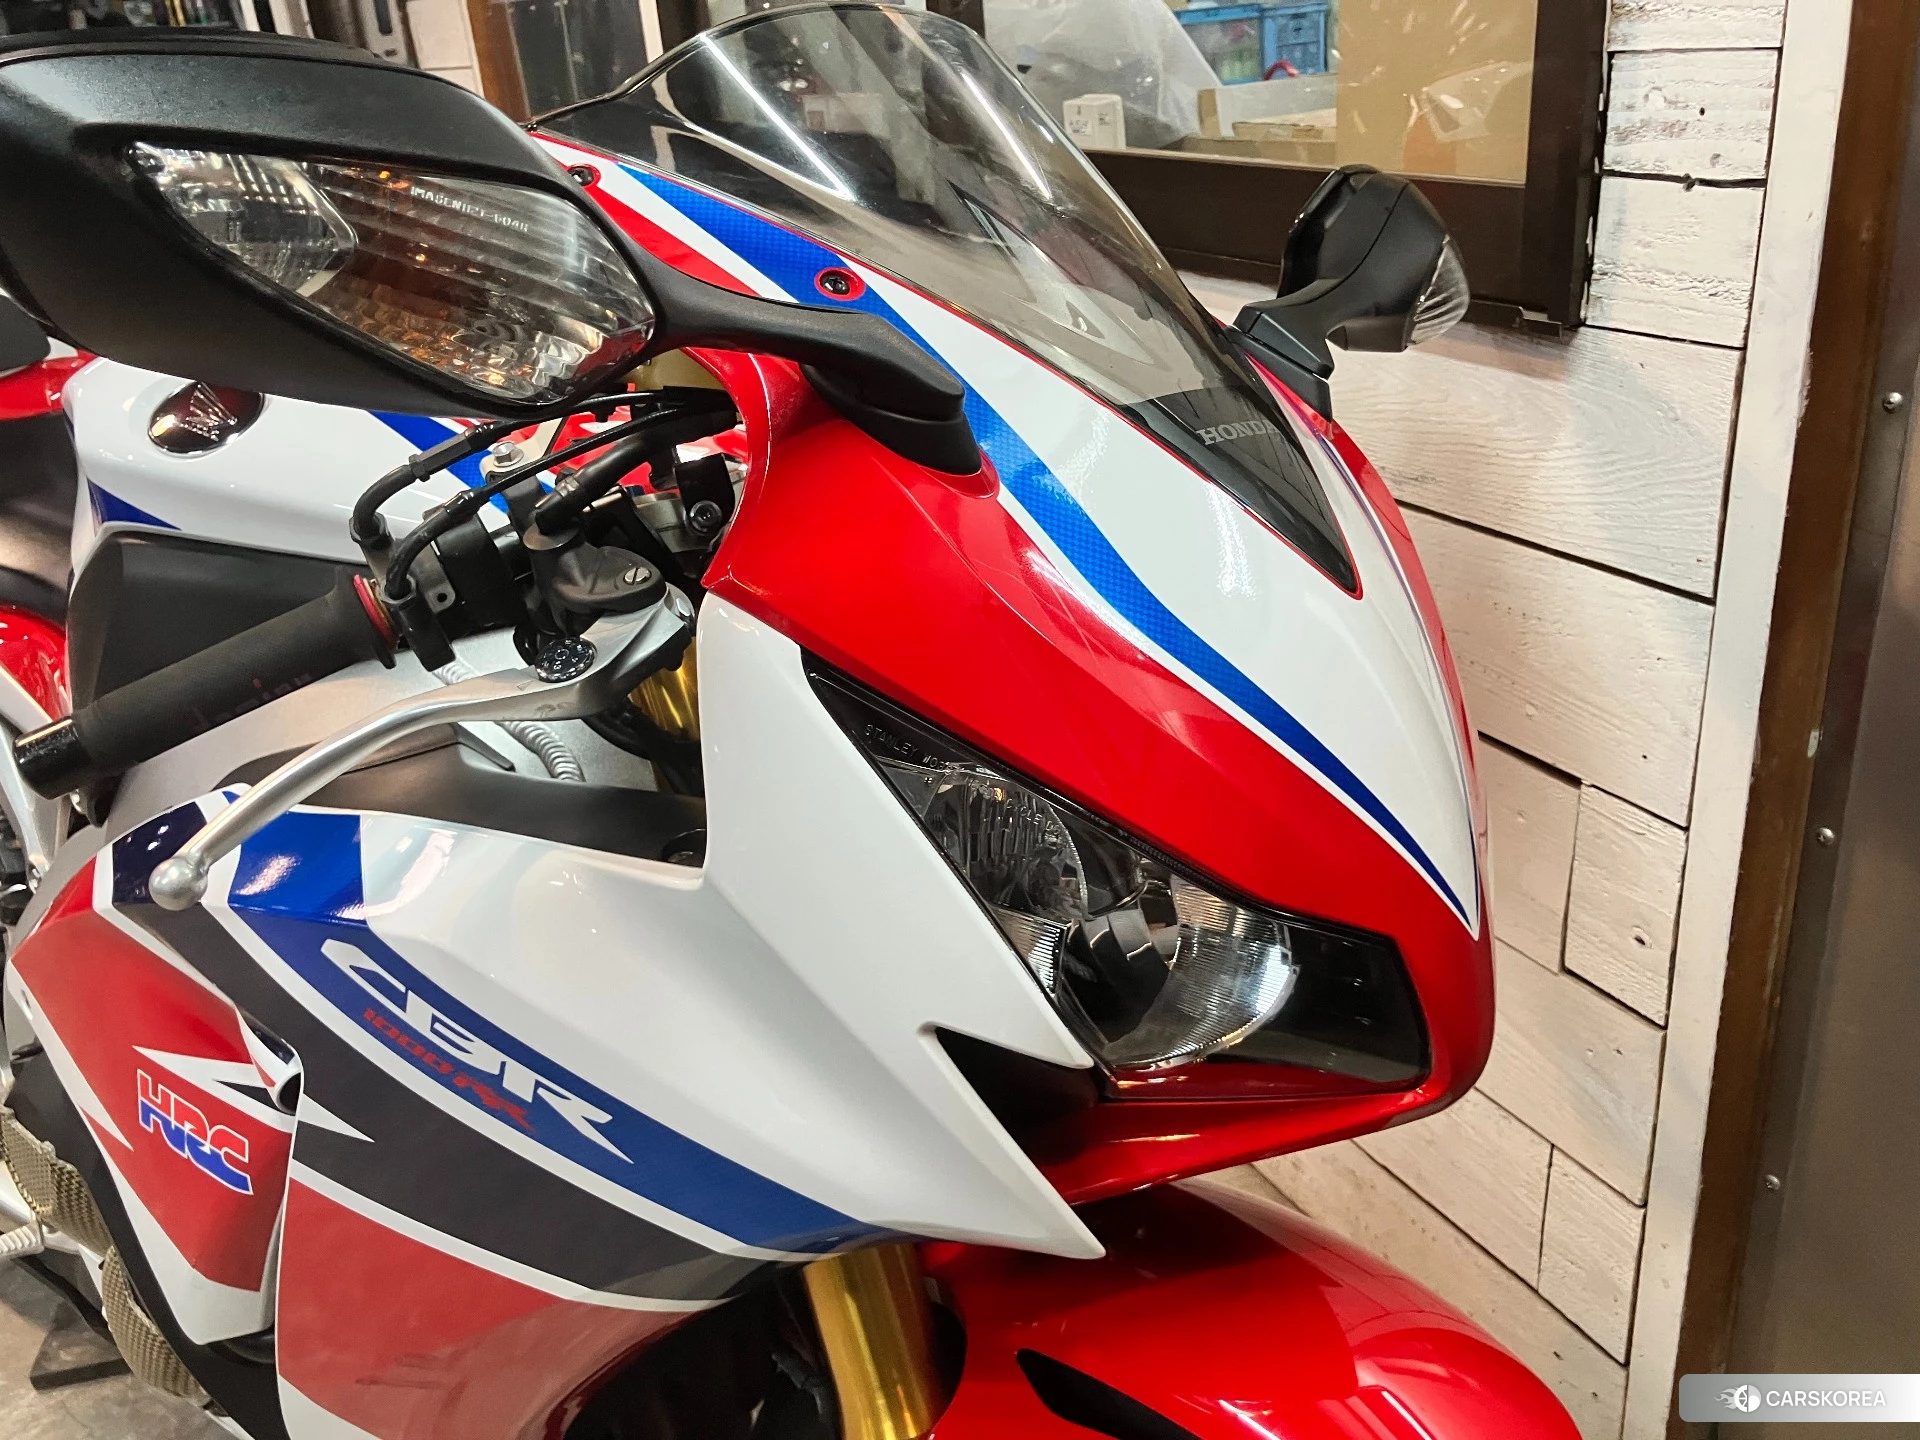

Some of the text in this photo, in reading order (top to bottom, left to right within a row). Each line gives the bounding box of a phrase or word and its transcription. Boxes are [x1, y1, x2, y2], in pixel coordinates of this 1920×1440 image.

[865, 724, 919, 758] STANLEY
[321, 939, 634, 1164] CBR
[137, 1068, 254, 1195] HRC
